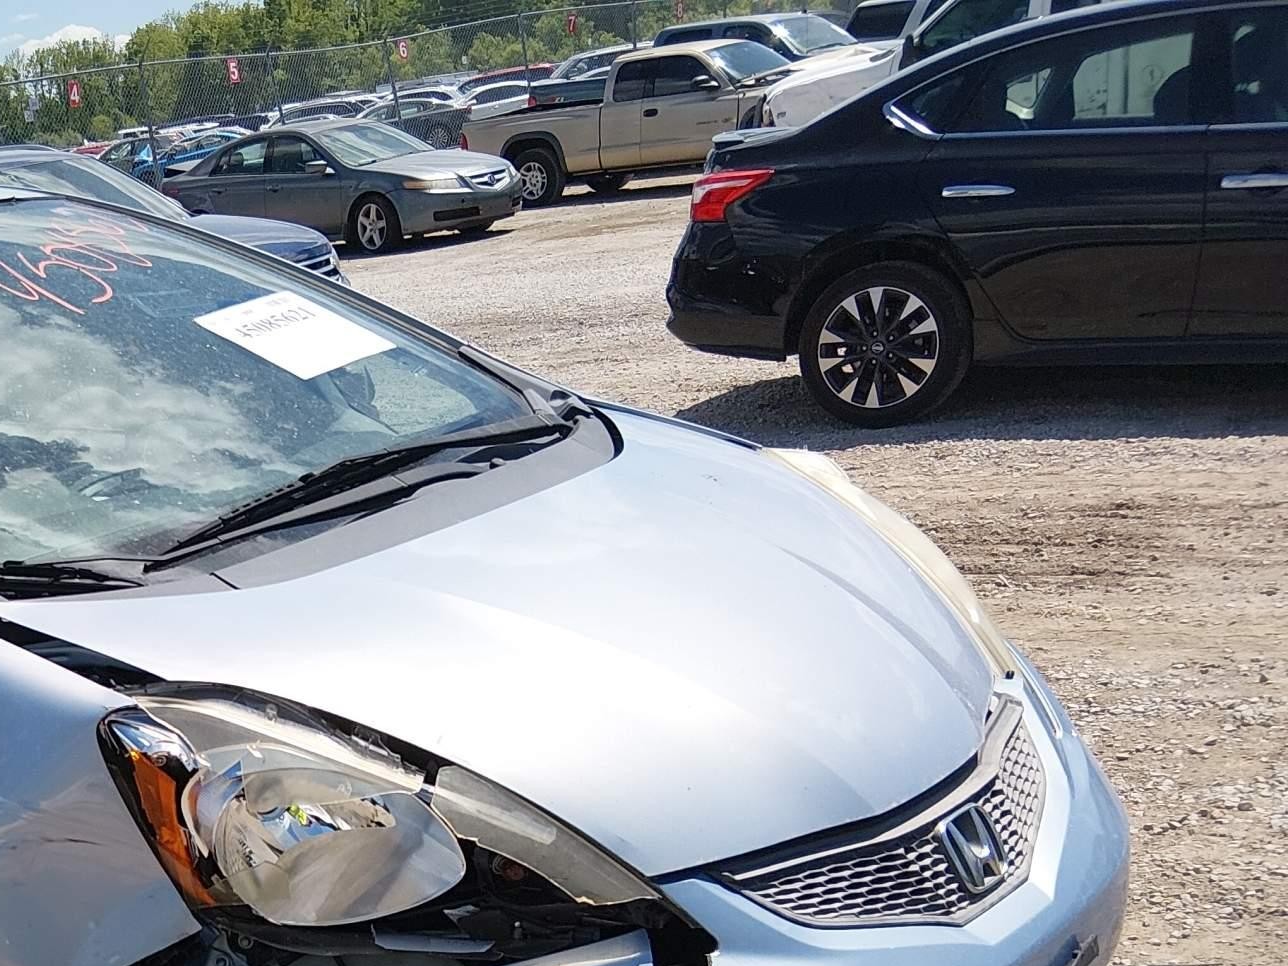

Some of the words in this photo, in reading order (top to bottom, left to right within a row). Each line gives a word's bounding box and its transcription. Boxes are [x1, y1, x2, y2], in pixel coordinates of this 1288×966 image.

[568, 15, 576, 31] 7
[399, 41, 408, 58] 6
[229, 62, 238, 80] 5
[70, 84, 80, 103] 4
